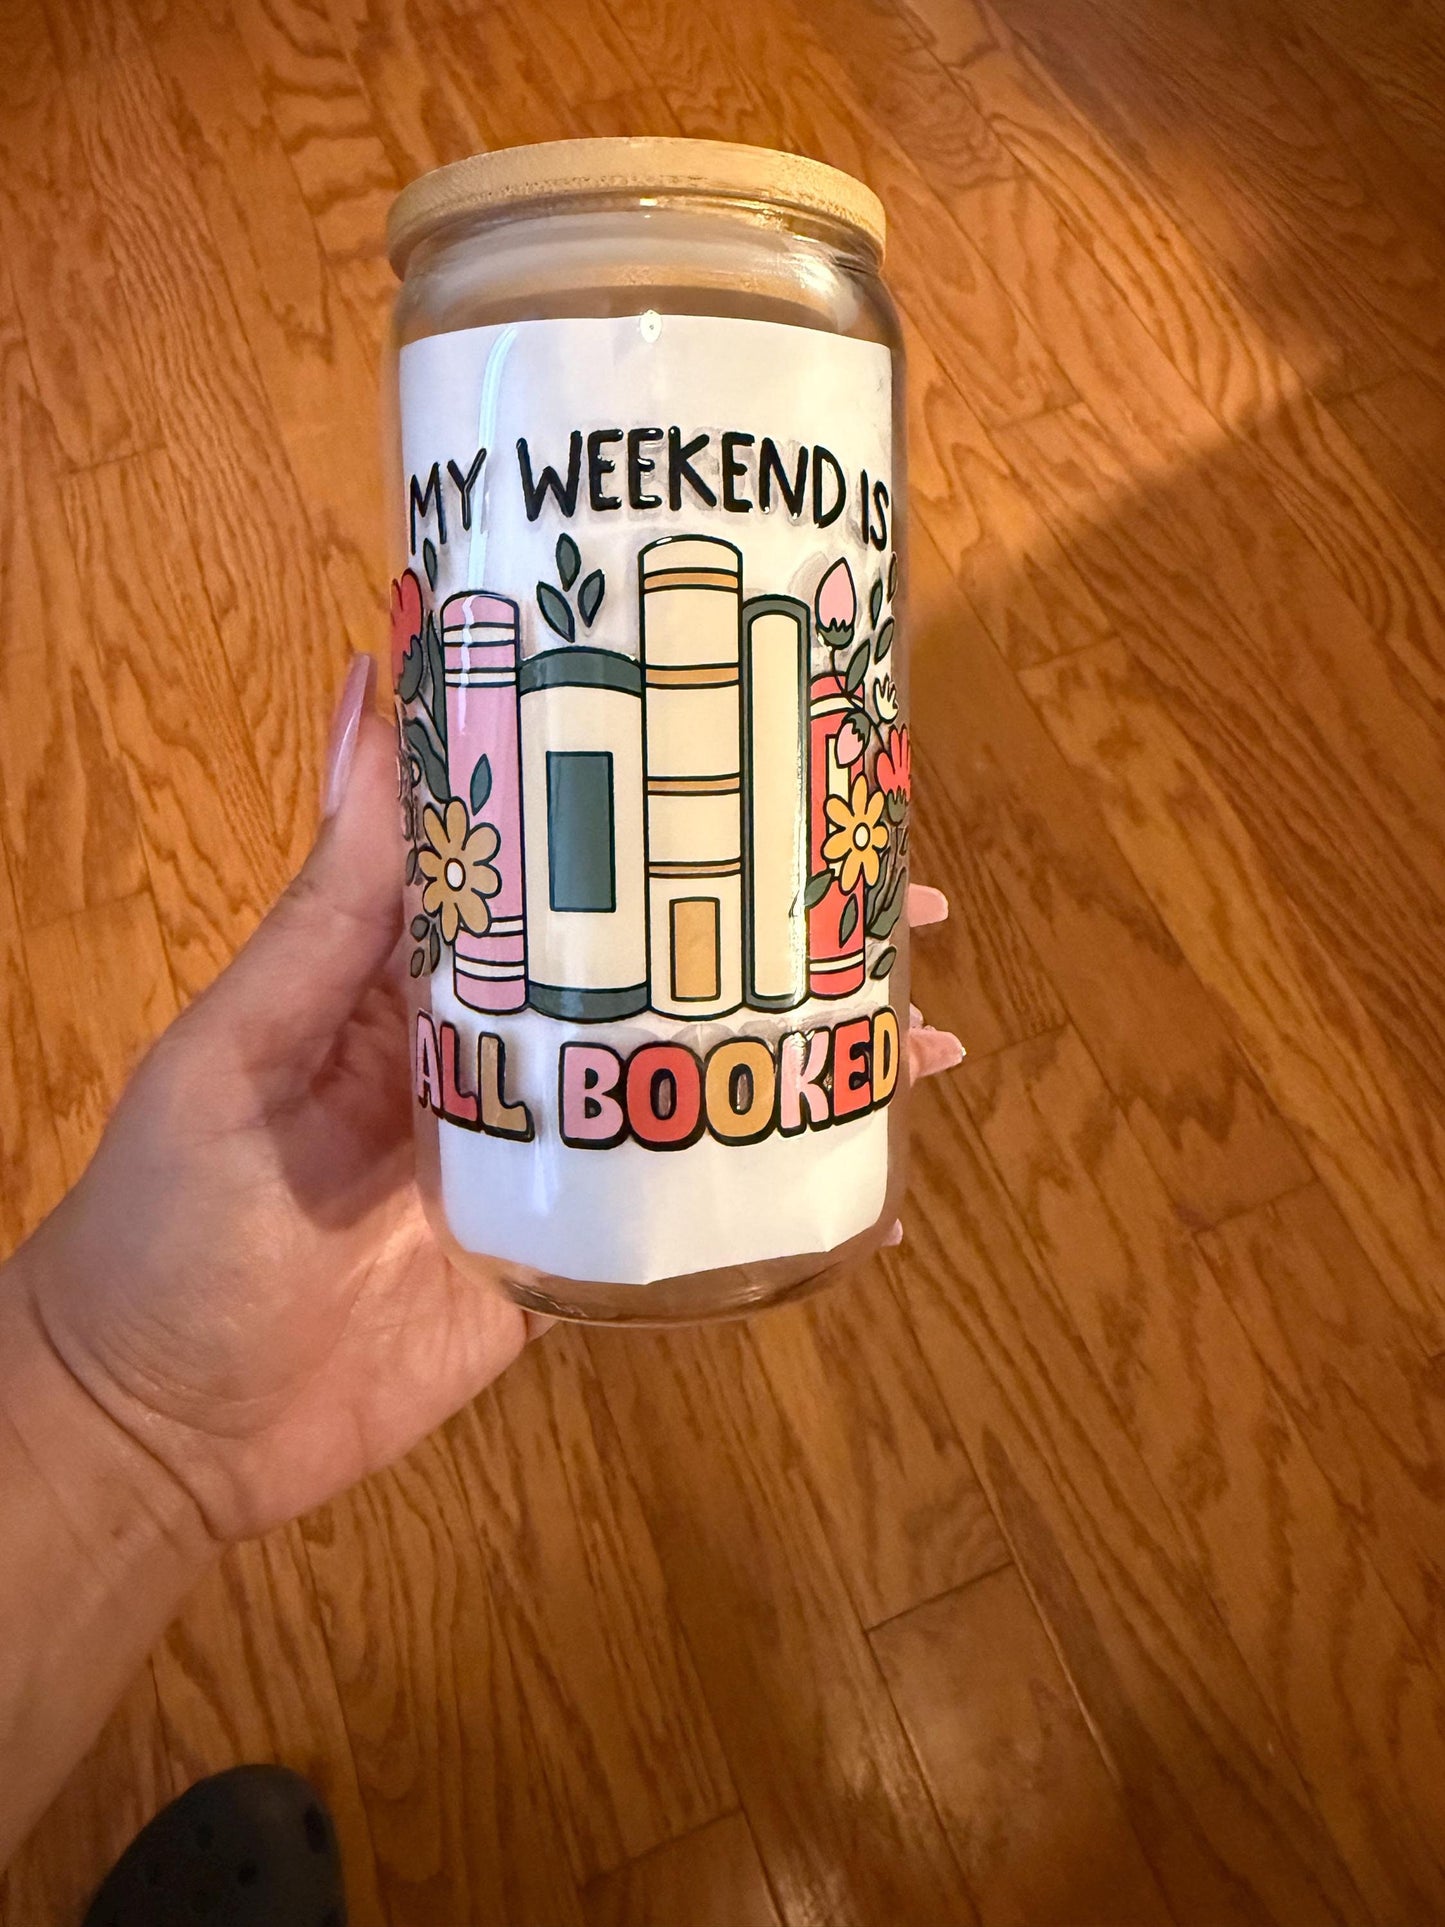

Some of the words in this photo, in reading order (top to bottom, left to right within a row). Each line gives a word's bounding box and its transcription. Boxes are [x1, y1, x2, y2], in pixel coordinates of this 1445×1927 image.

[410, 448, 487, 555] MY
[516, 426, 847, 528] WEEKEND
[861, 469, 890, 551] IS
[415, 1008, 535, 1142] ALL
[558, 1005, 900, 1151] BOOKED
